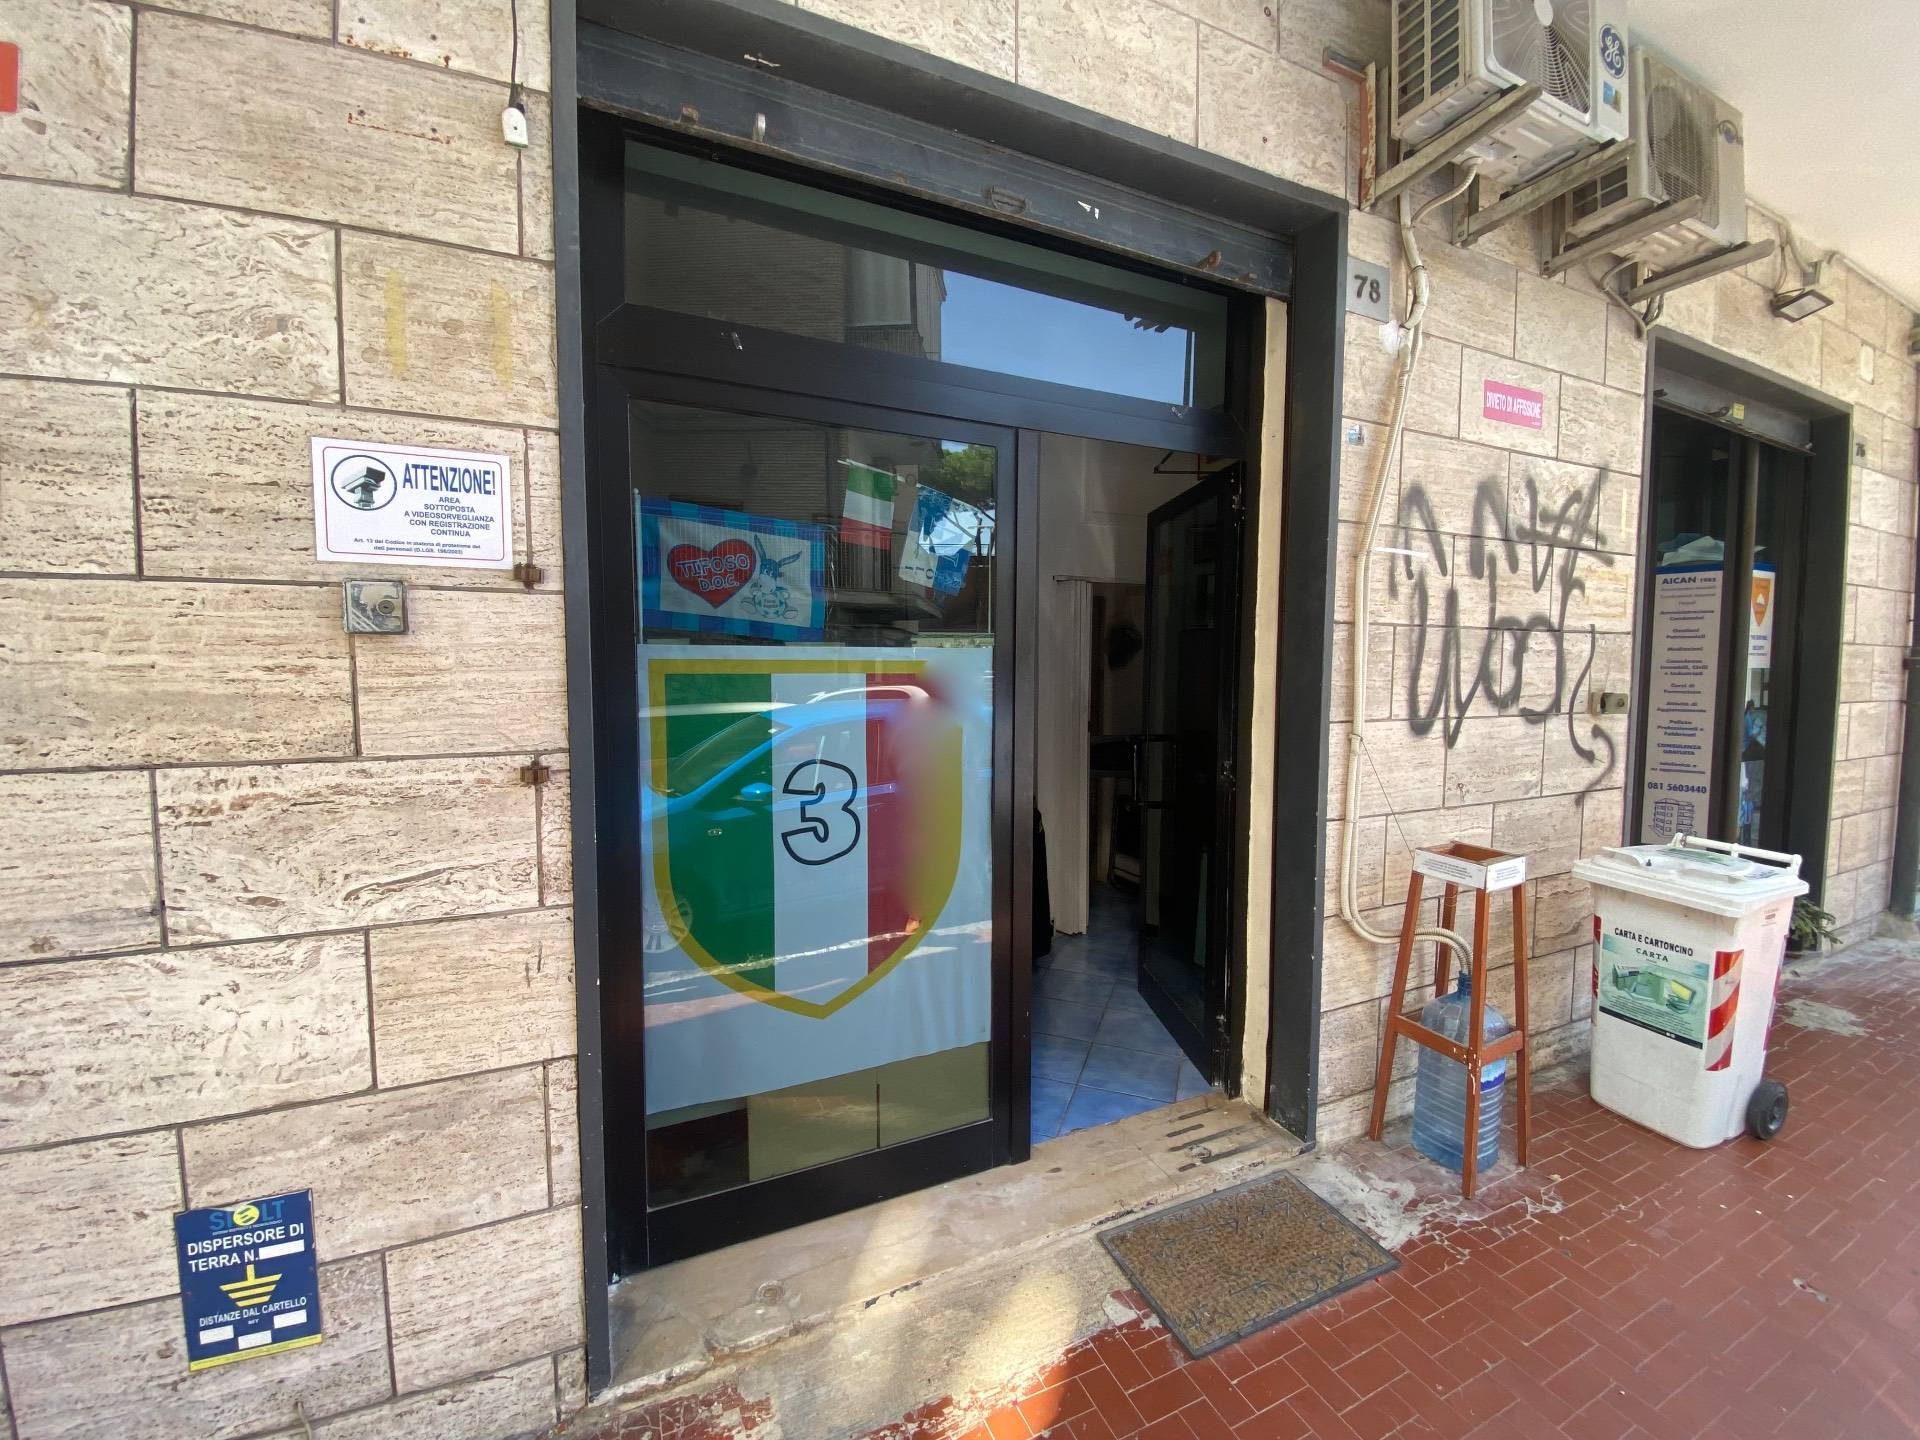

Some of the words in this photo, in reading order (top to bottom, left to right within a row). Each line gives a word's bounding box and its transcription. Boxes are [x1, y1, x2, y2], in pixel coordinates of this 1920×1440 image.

[1354, 274, 1381, 303] 78
[403, 462, 496, 495] ATTENZIONE!
[424, 503, 476, 513] SOTTOPOSTA
[438, 496, 460, 504] AREA
[411, 511, 495, 523] VIDEOSORVEGLIANZA
[428, 520, 491, 530] REGISTRAZIONE
[430, 528, 471, 537] CONTINUA
[675, 553, 750, 578] TIFOSO
[699, 574, 740, 592] D.O.C.
[1662, 576, 1697, 585] AICAN
[1647, 782, 1664, 790] 081
[780, 758, 861, 865] 3
[1614, 927, 1637, 942] CARTA
[1637, 934, 1643, 943] E
[1644, 936, 1694, 957] CARTONCINO
[1635, 947, 1669, 962] CARTA
[187, 1226, 286, 1256] DISPERSORE
[289, 1222, 304, 1237] DI
[188, 1252, 241, 1273] TERRA
[244, 1249, 259, 1263] N.
[199, 1310, 241, 1327] DISTANZE
[242, 1307, 261, 1318] DAL
[261, 1296, 307, 1314] CARTELLO
